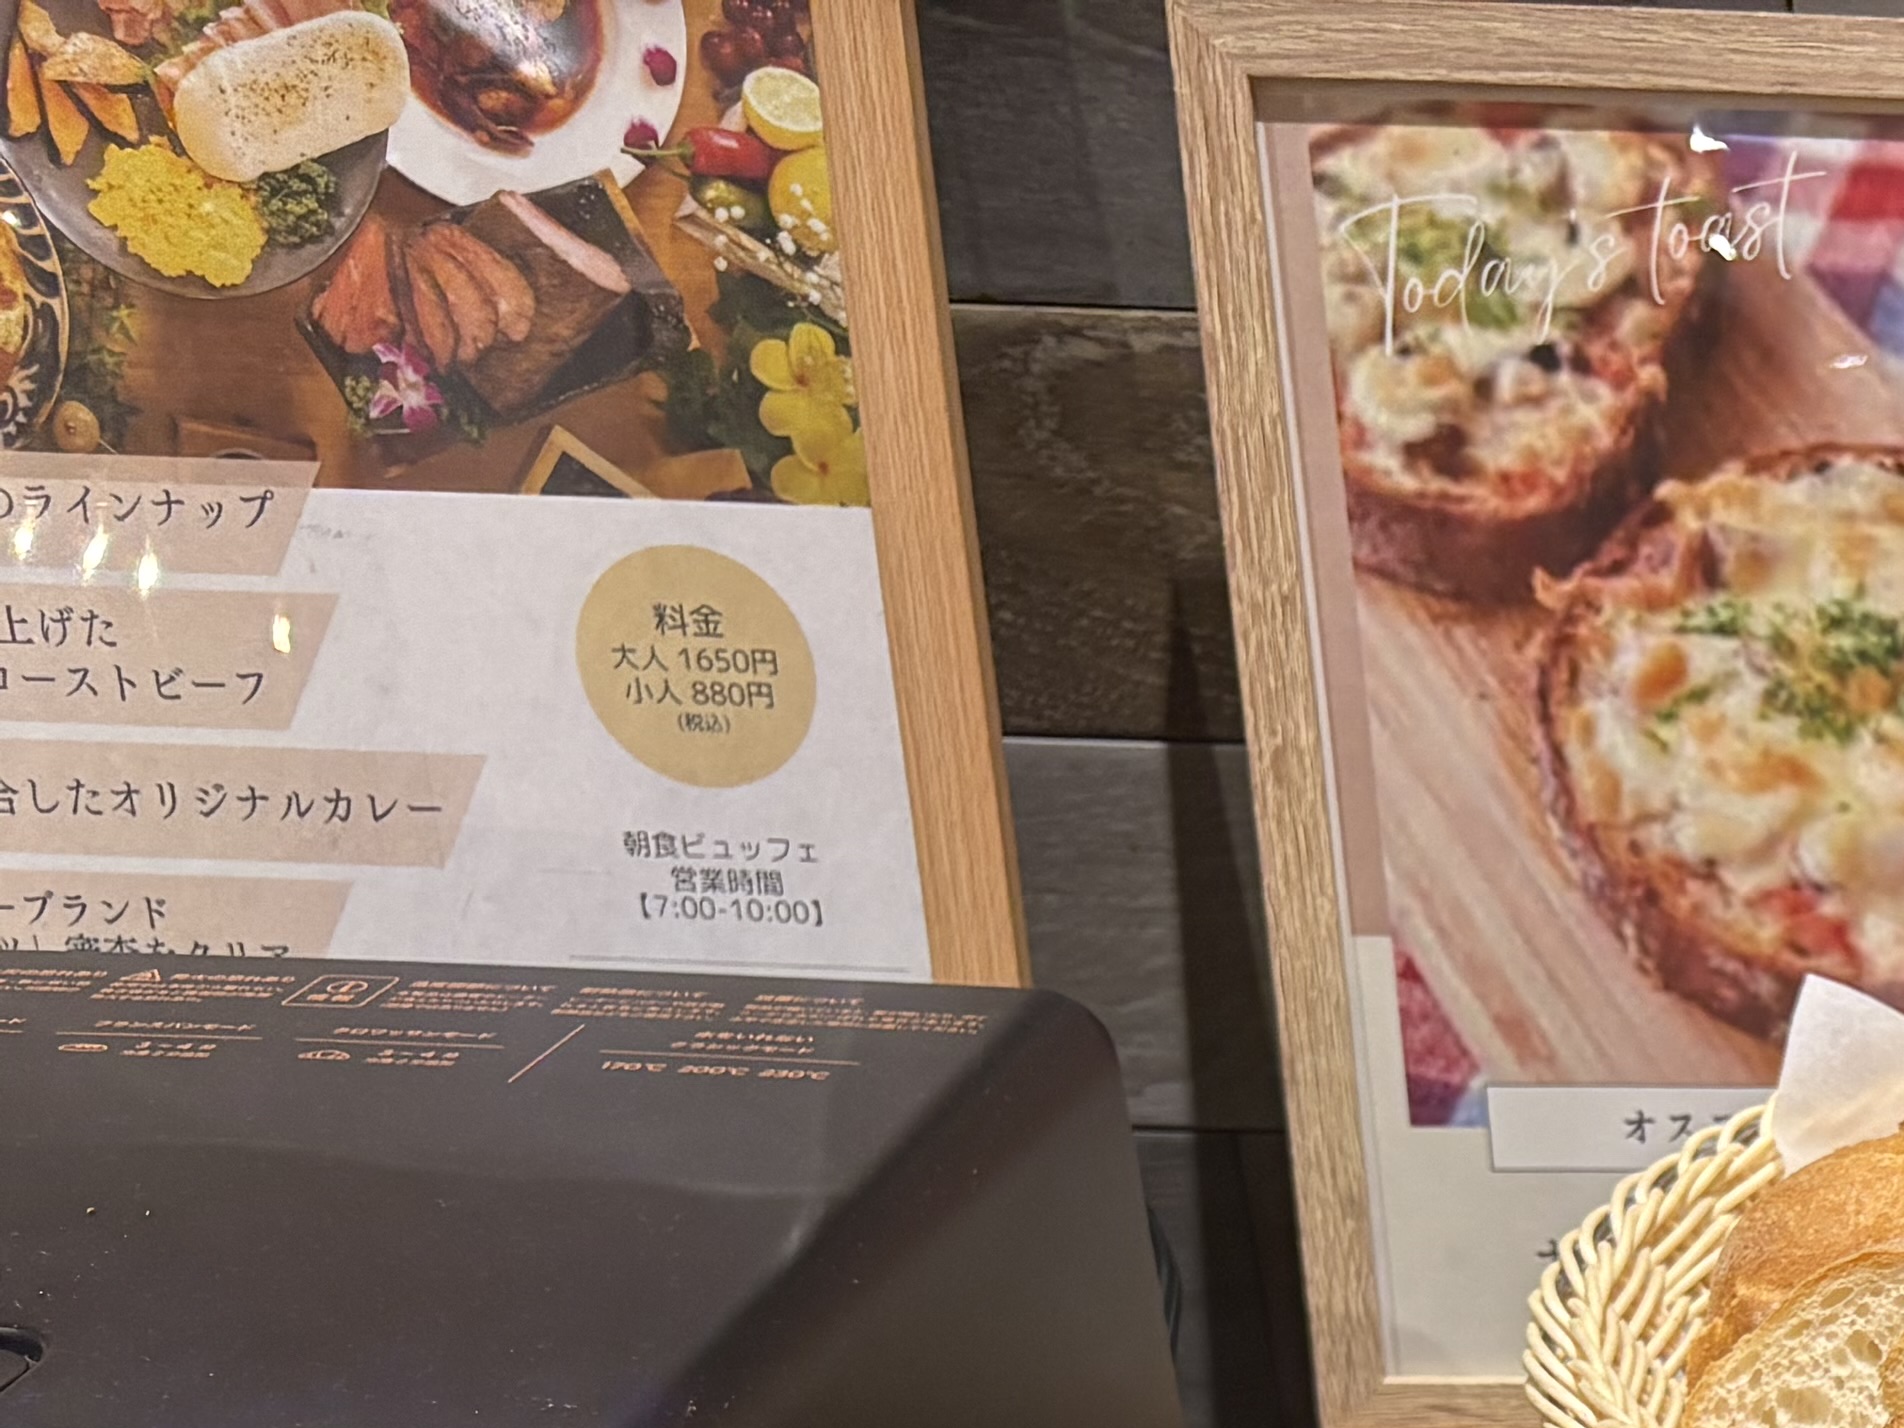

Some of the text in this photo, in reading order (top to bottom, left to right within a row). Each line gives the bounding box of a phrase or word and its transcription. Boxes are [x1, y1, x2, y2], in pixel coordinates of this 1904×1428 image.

[0, 604, 118, 648] 上げた
[653, 604, 724, 639] 料金
[612, 644, 779, 676] 大人 1650円
[0, 665, 265, 704] ーストビーフ
[626, 677, 775, 709] 小人 880円
[677, 712, 731, 733] (税込)
[623, 831, 819, 863] 朝食ビュッフェ
[671, 866, 785, 897] 営業時間
[639, 892, 824, 927] 【7:00-10:00】
[1624, 1110, 1731, 1144] オス
